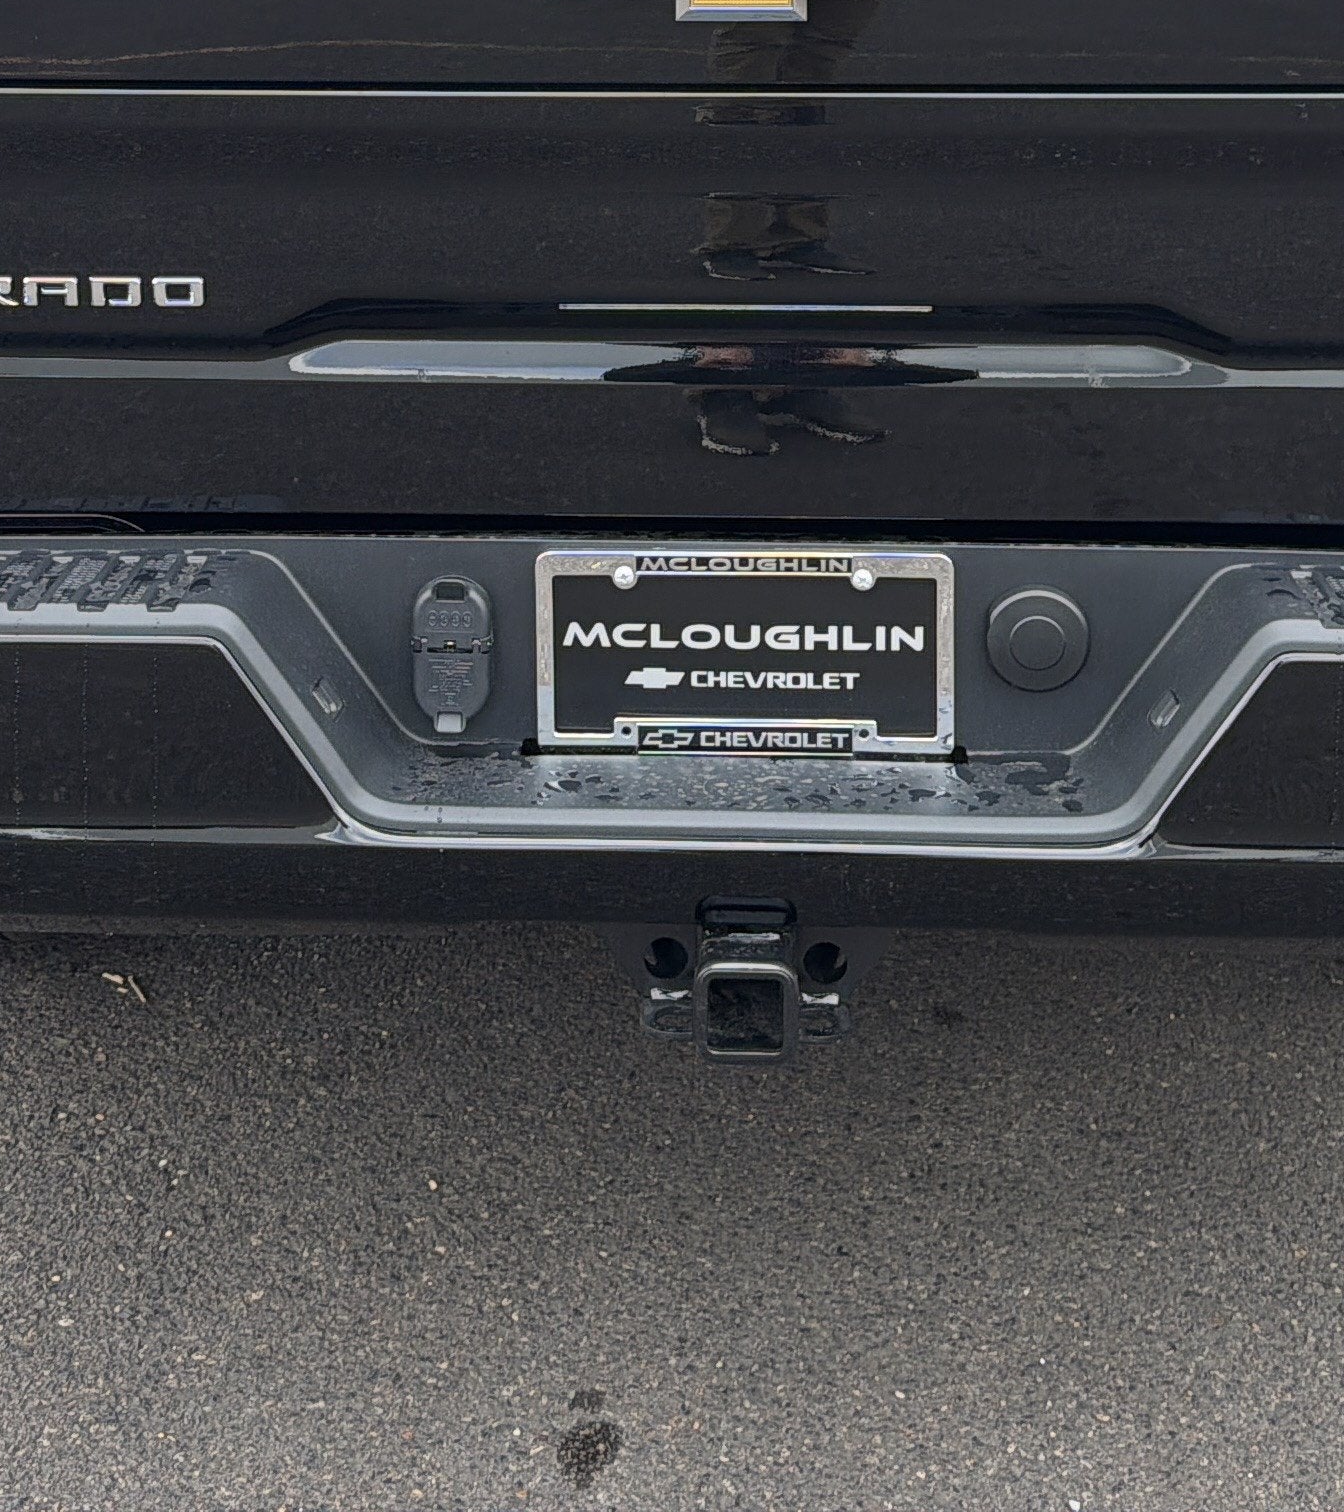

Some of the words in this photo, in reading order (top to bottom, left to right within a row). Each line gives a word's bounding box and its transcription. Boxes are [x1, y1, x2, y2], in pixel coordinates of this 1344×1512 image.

[640, 556, 849, 572] MCLOUGHLIN
[562, 621, 925, 652] MCLOUGHLIN
[690, 671, 860, 690] CHEVROLET
[699, 731, 849, 749] CHEVROLET
